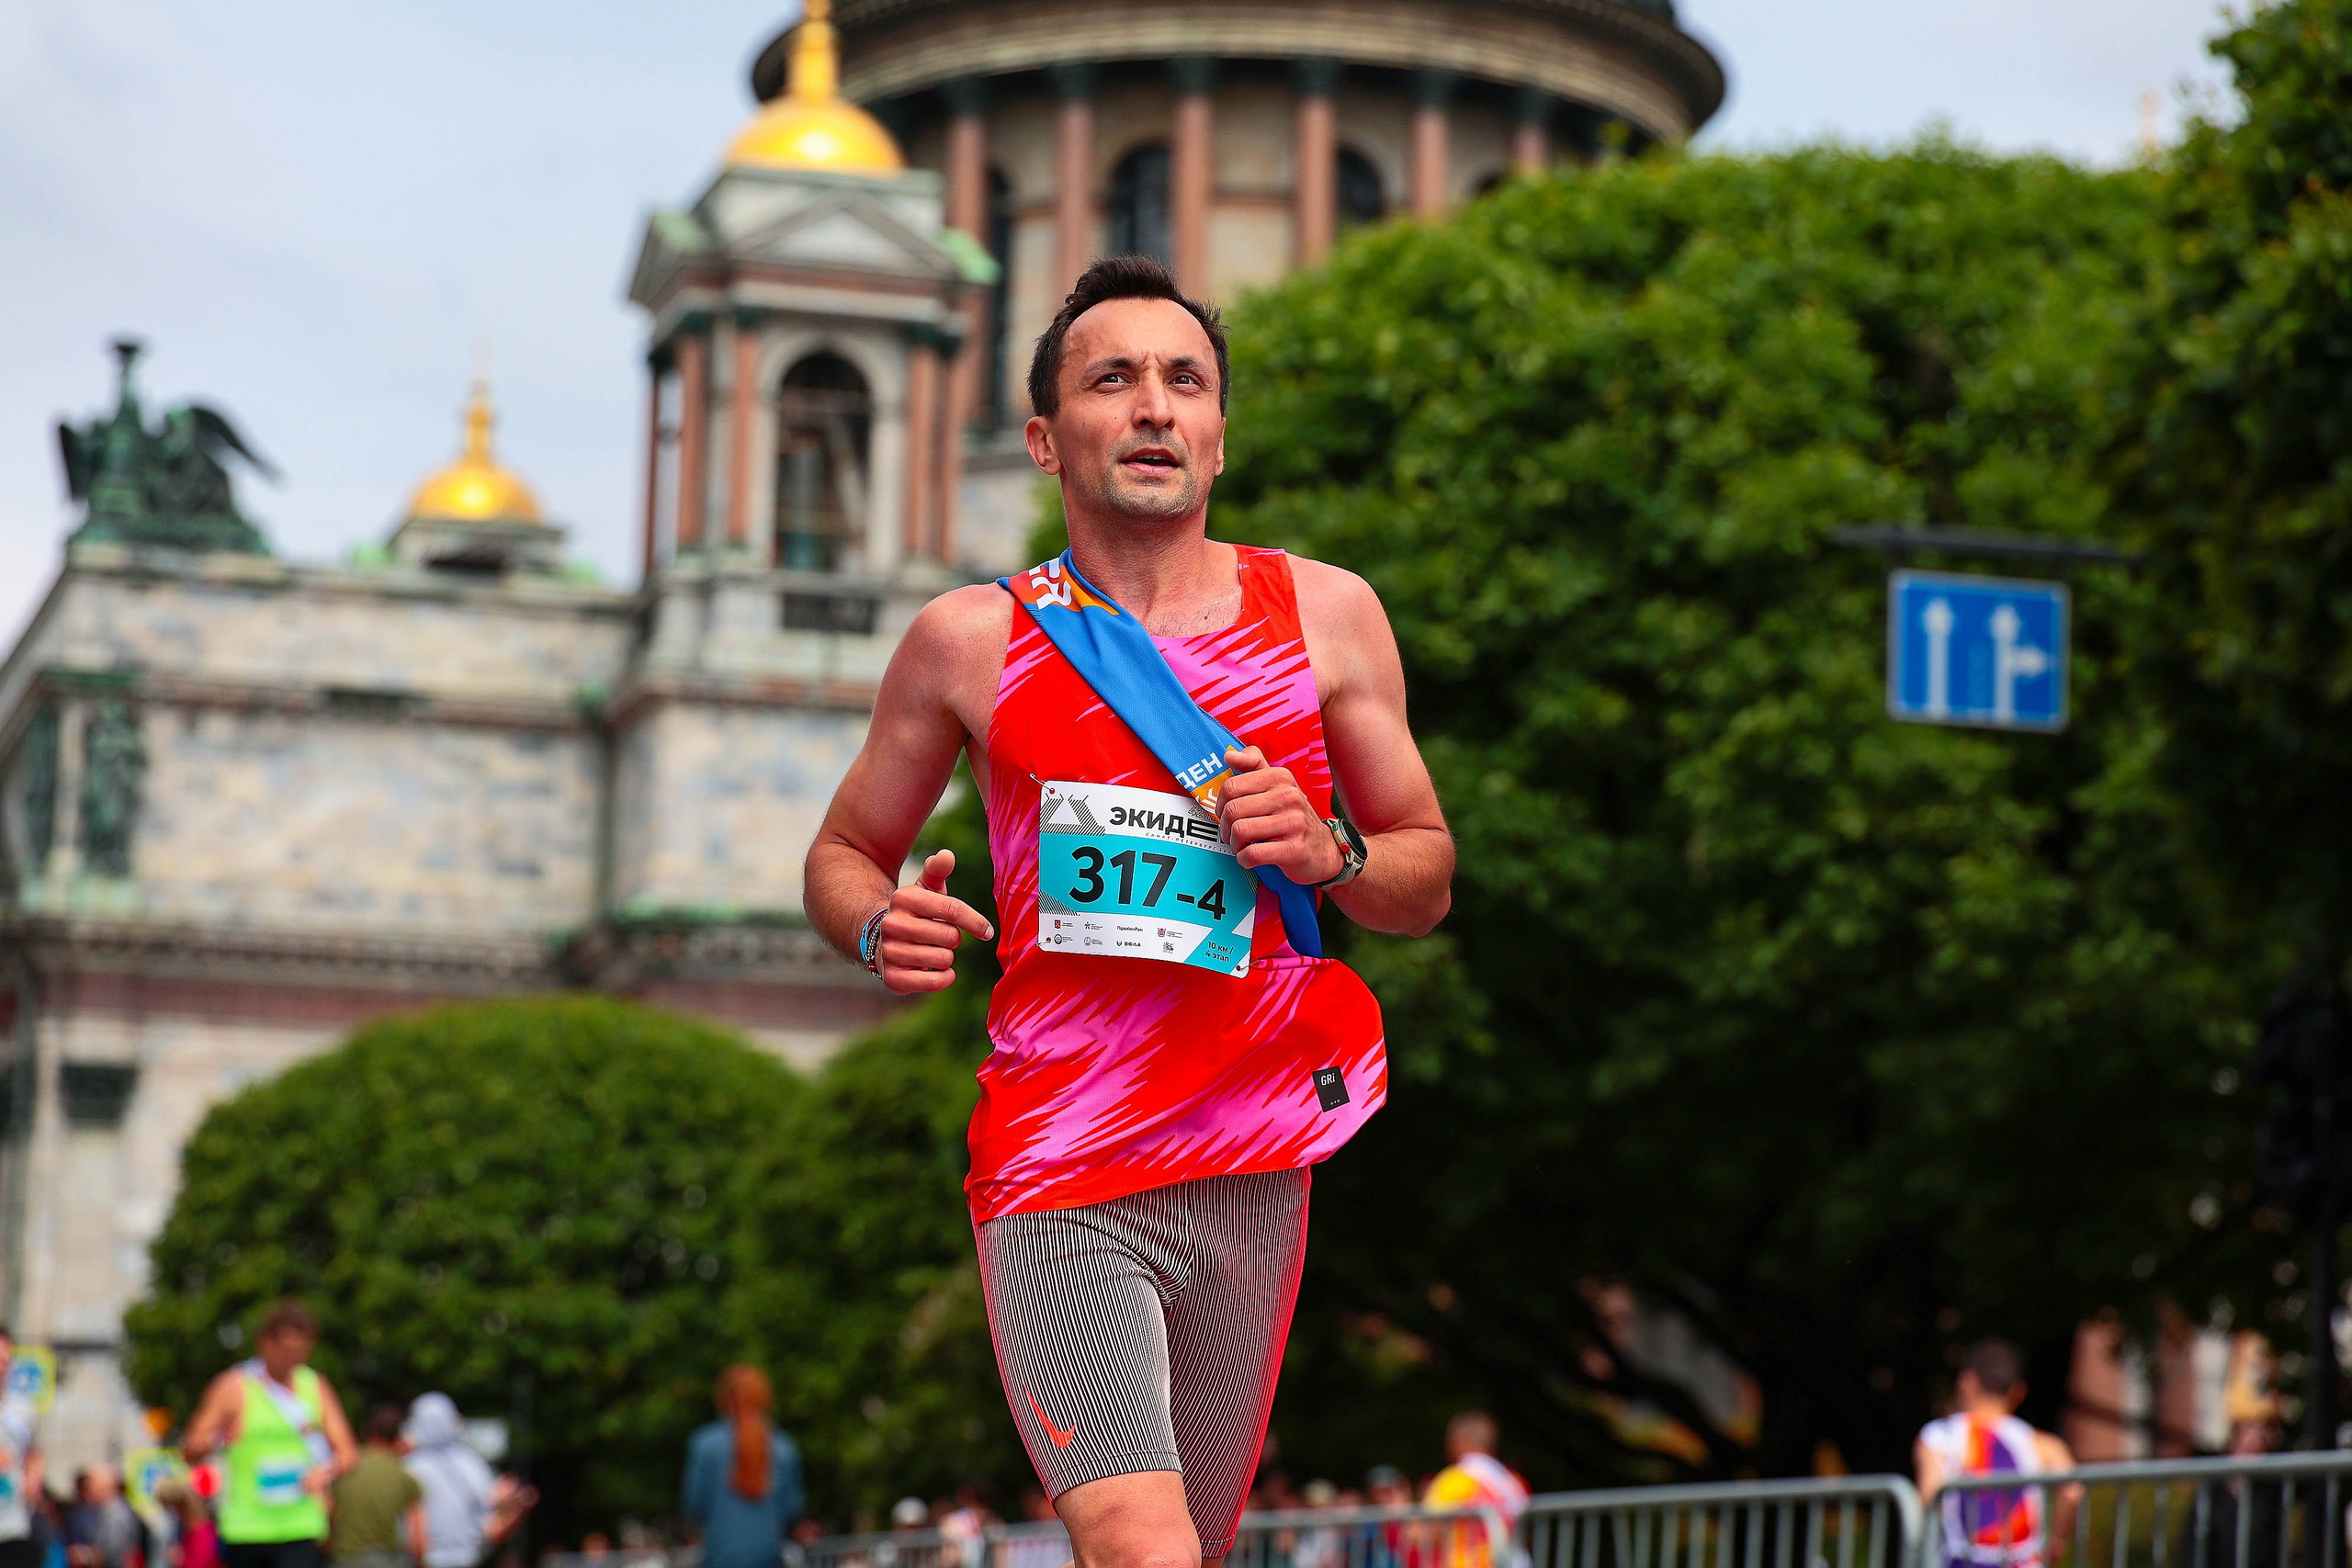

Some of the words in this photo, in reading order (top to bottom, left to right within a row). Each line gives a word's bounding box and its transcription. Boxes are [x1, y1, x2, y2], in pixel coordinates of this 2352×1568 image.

[1109, 807, 1226, 844] ЭКИДЕ
[1069, 846, 1227, 920] 317-4
[1207, 941, 1216, 950] 10
[1212, 953, 1229, 963] этап
